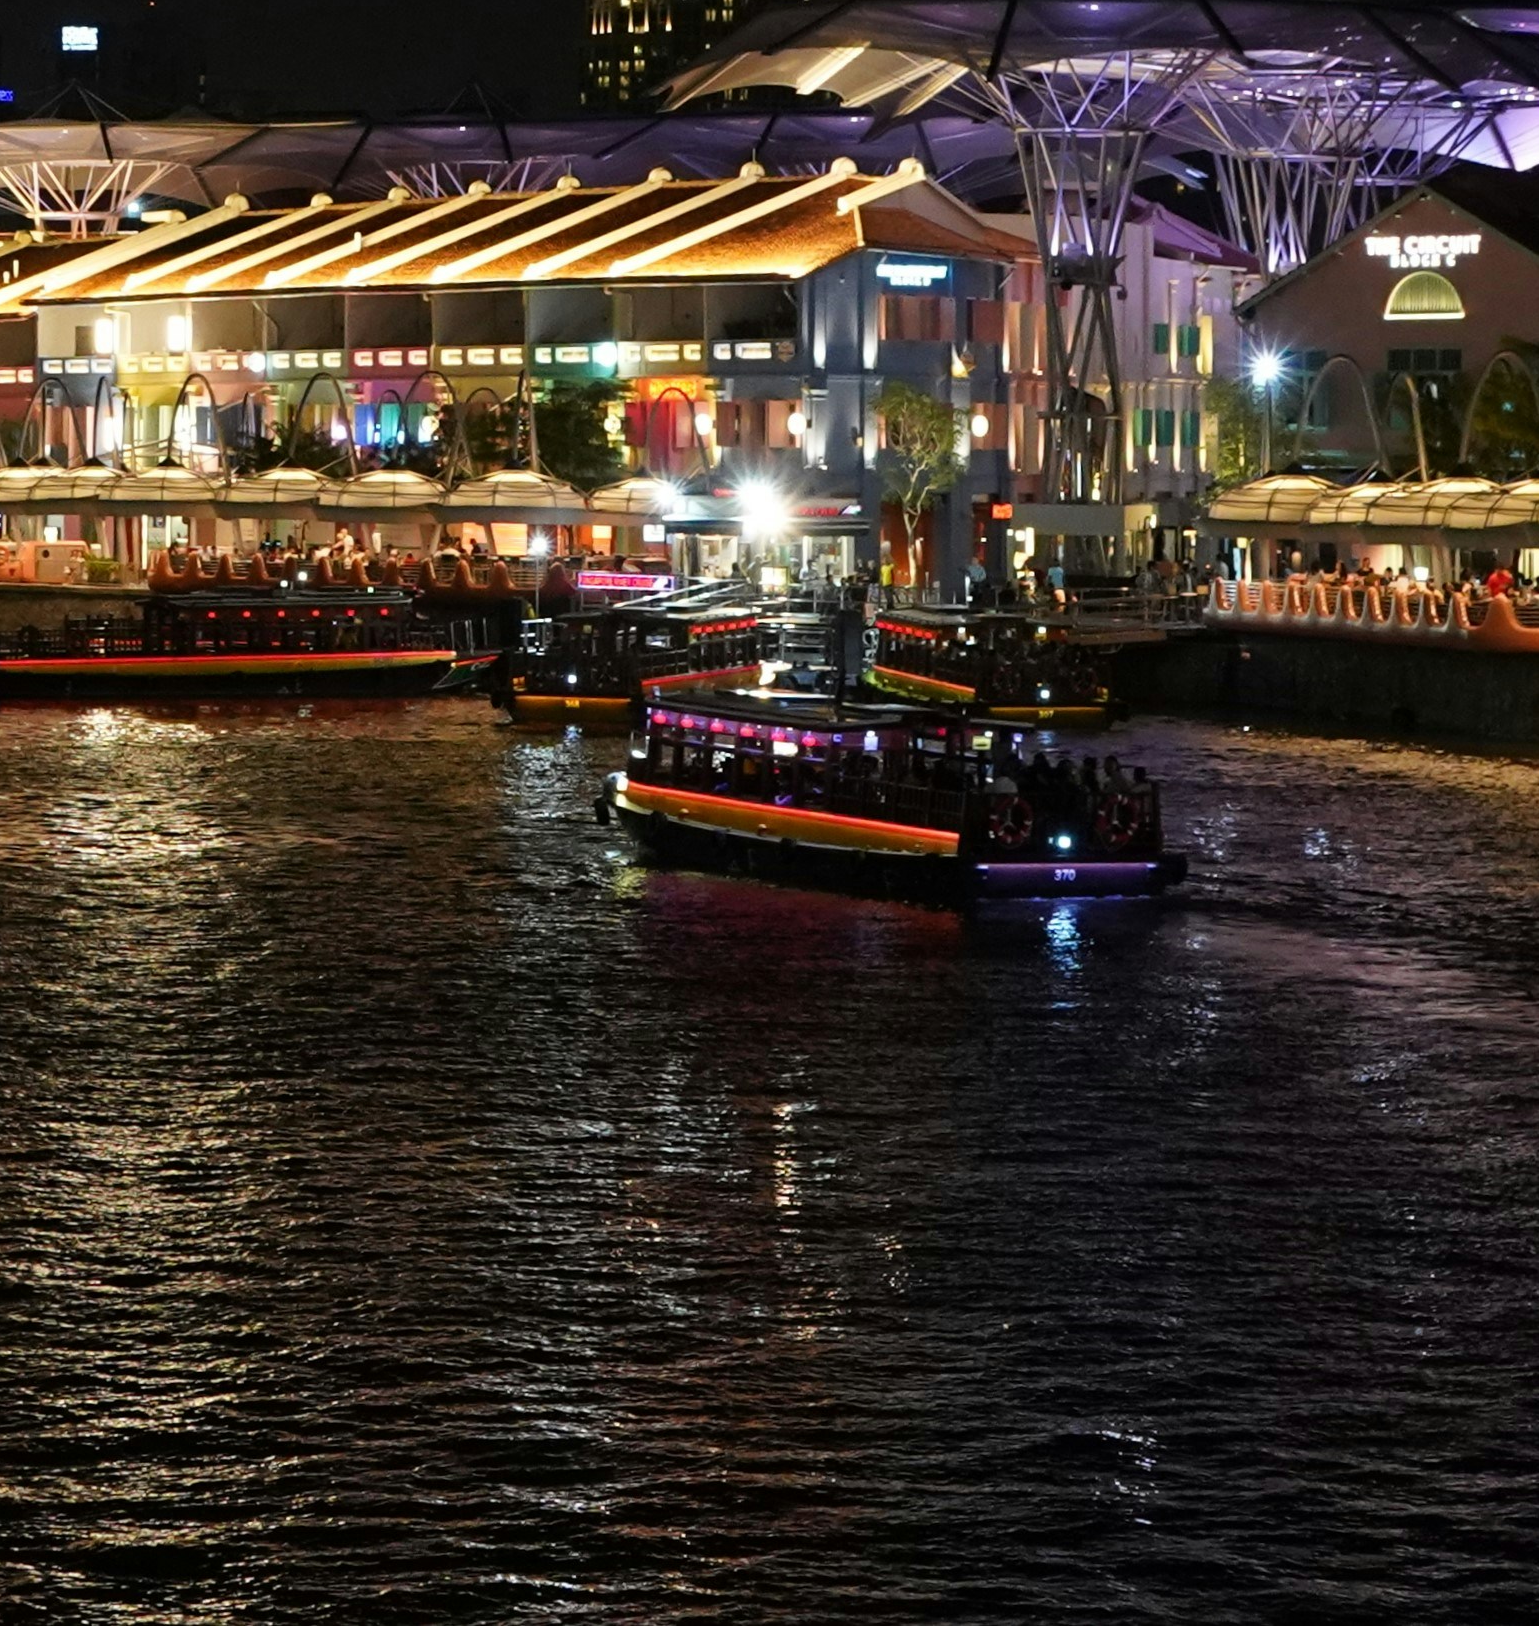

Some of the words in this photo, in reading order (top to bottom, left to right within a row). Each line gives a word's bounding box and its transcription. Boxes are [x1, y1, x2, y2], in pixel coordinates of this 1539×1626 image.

[1364, 236, 1401, 256] THE
[1403, 234, 1482, 255] CIRCUIT
[1389, 254, 1441, 269] BLOCK
[1054, 868, 1076, 881] 370
